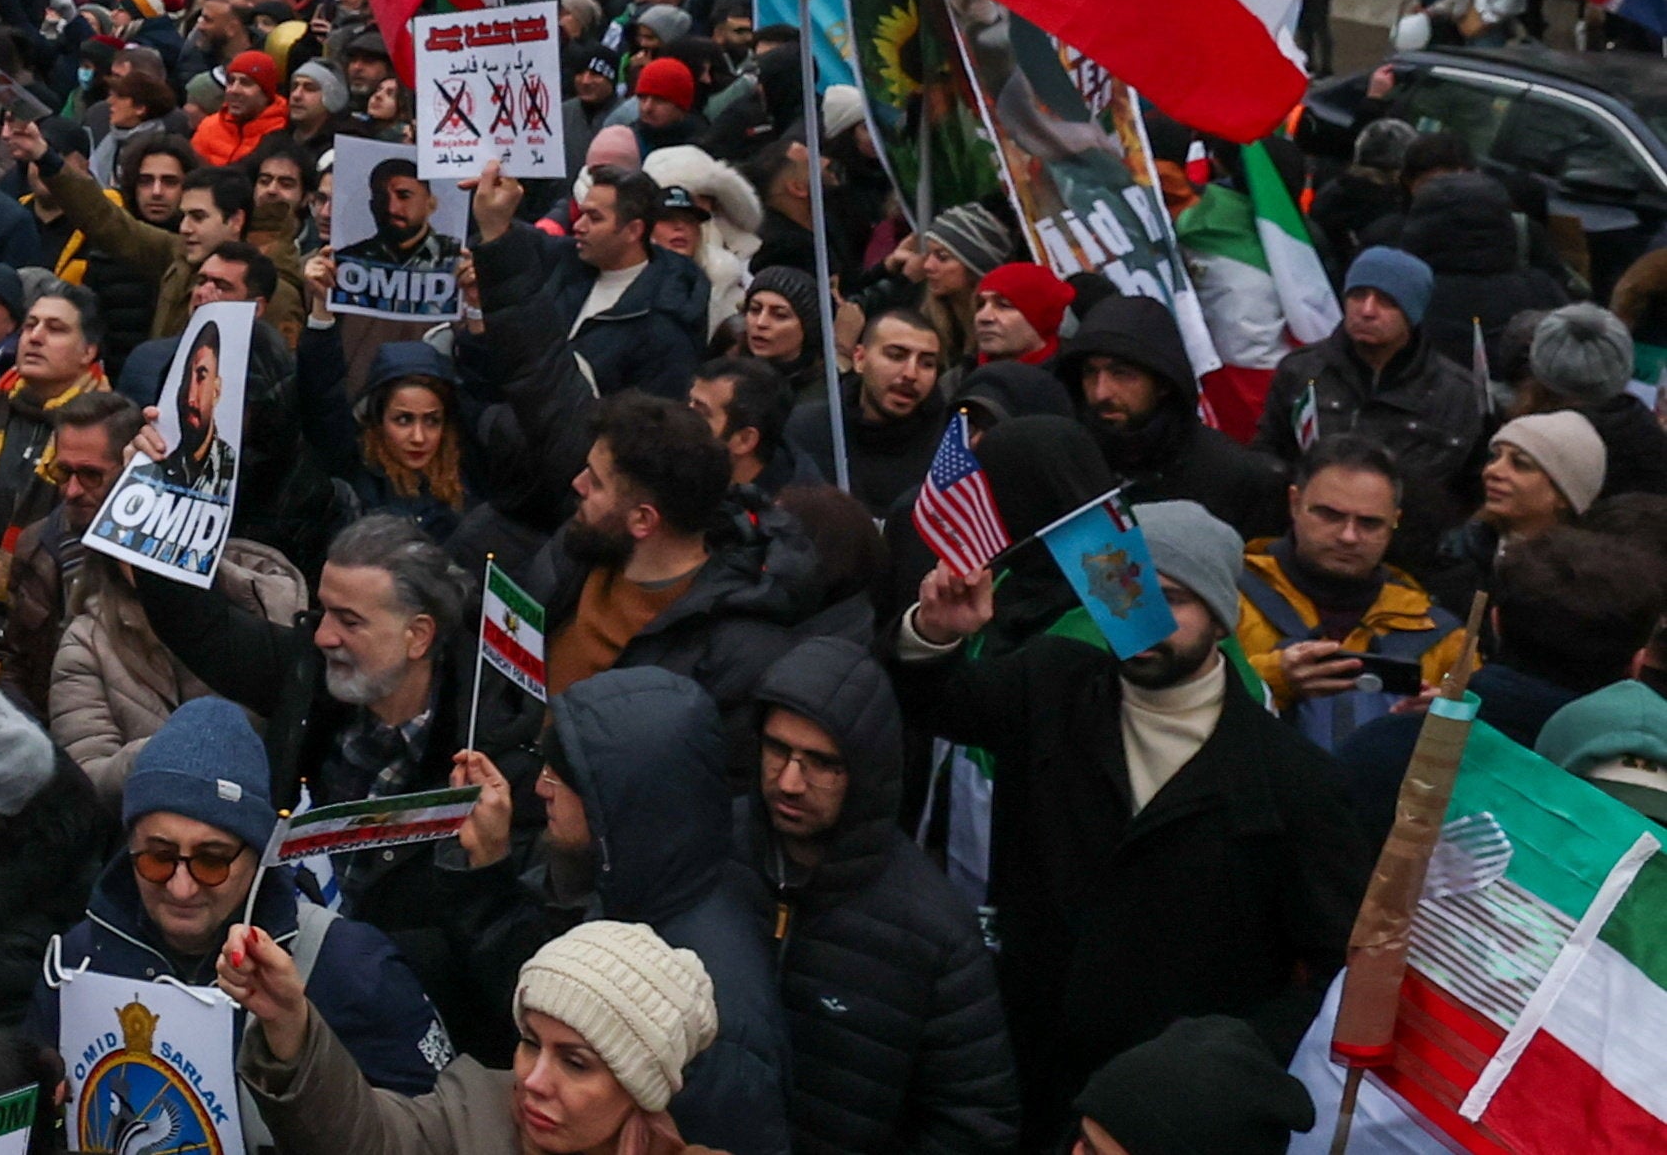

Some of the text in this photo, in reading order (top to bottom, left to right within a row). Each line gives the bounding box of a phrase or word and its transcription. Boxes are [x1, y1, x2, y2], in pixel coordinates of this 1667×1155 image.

[336, 262, 456, 303] OMID
[111, 483, 227, 553] OMID
[75, 1031, 229, 1126] OMID SARLAK
